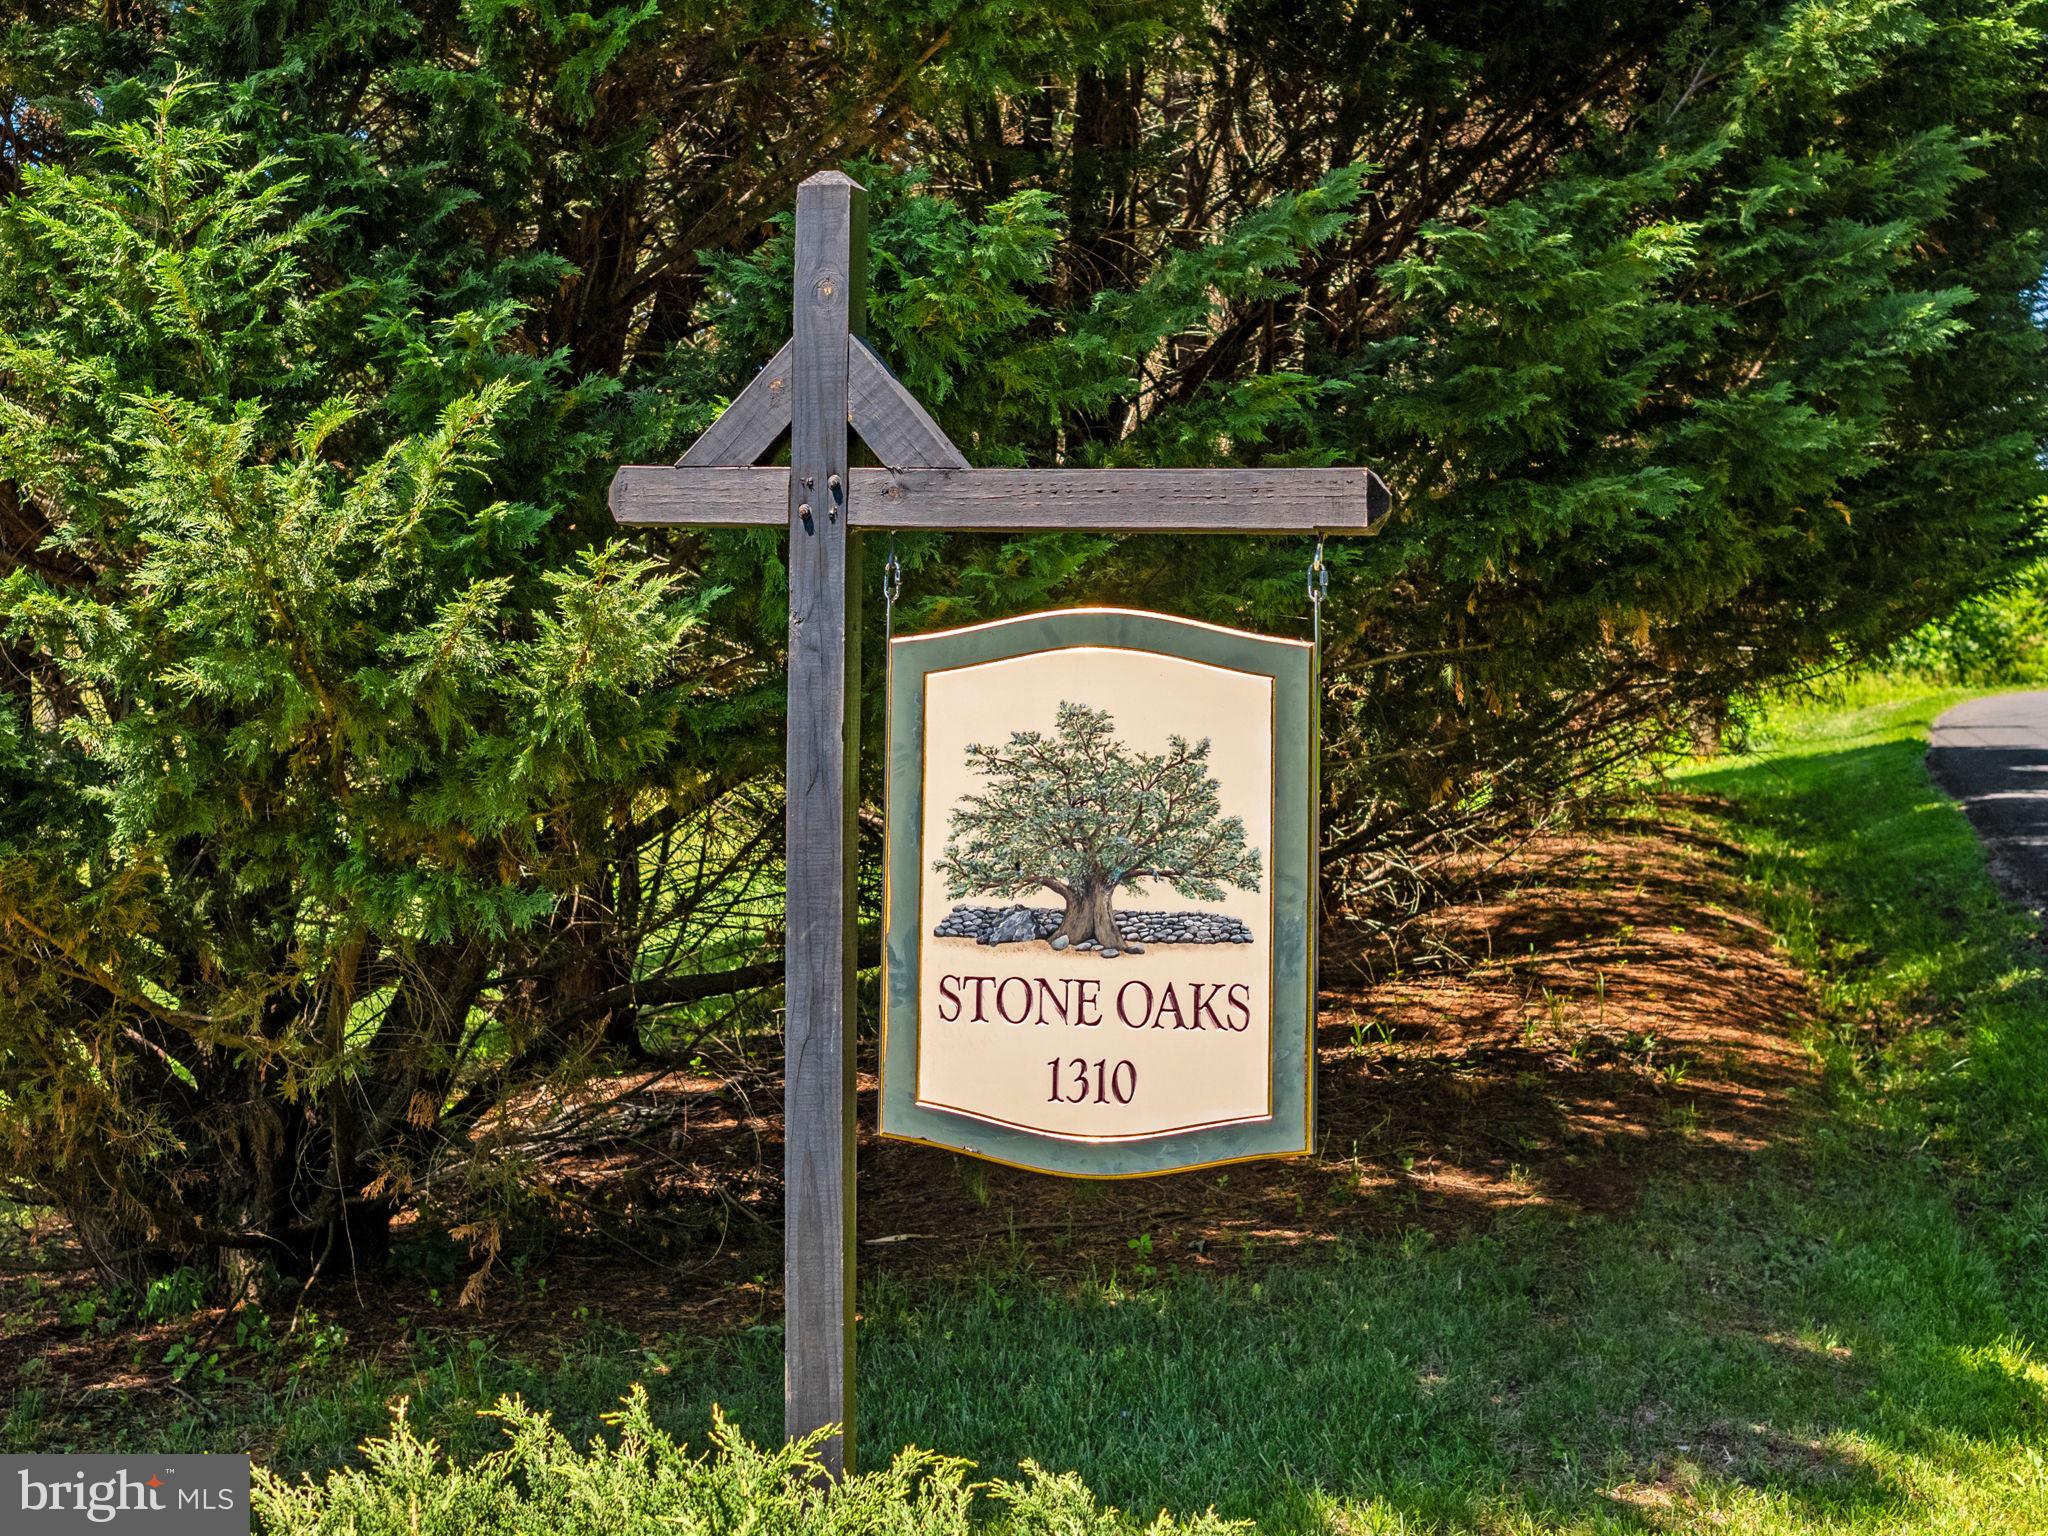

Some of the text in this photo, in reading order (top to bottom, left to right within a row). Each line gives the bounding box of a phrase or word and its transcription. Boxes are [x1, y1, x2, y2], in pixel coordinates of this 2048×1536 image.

[938, 974, 1252, 1033] STONE OAKS
[1046, 1056, 1138, 1105] 1310
